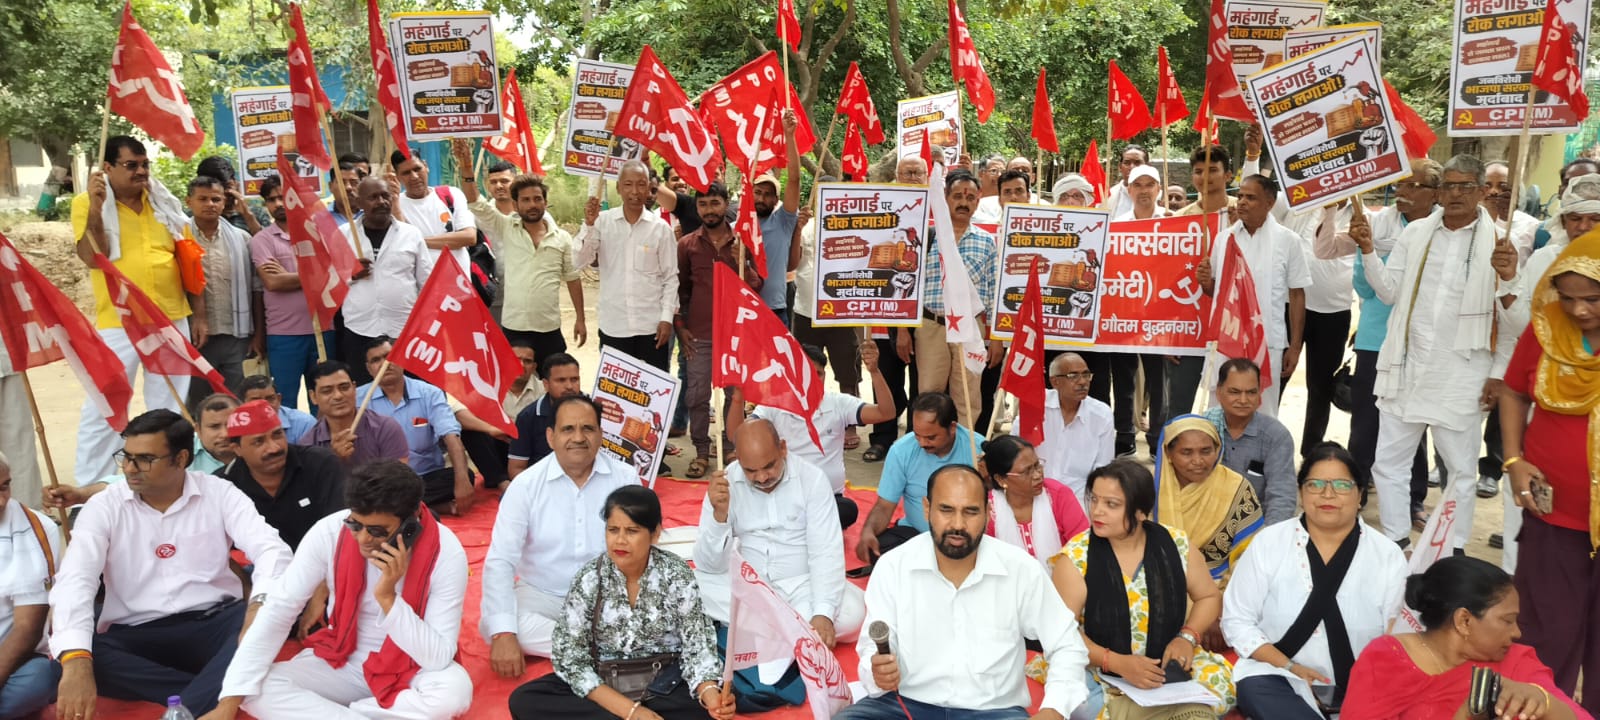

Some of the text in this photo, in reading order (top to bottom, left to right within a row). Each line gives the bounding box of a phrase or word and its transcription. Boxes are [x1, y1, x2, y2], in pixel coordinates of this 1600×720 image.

[1230, 8, 1279, 25] महंगाई
[1467, 10, 1545, 32] रोक लगाओ
[403, 21, 463, 40] महंगाई पर
[1230, 25, 1287, 39] रोक लगाओ
[407, 38, 468, 54] रोक लगाओ!
[579, 68, 626, 86] महंगाई पर
[1257, 62, 1332, 101] महंगाई पर
[238, 95, 277, 113] महंगाई
[1267, 75, 1343, 117] रोक लगाओ!
[438, 115, 483, 126] CPI (M)
[1489, 107, 1553, 120] CPI (M)
[586, 155, 605, 166] CP
[610, 158, 624, 169] (M
[1288, 142, 1357, 172] भाजपा सरकार
[1319, 167, 1353, 187] CPI
[1355, 160, 1377, 176] (M)
[825, 193, 893, 213] महंगाई पर
[827, 213, 897, 230] रोक लगाओ!
[1010, 214, 1075, 233] महंगाई पर
[1011, 233, 1077, 247] रोक लगाओ!
[827, 279, 888, 287] भाजपा सरकार
[847, 301, 898, 311] CPI (M)
[1056, 319, 1075, 329] (M)
[1142, 315, 1202, 341] बुद्धनगर)
[602, 362, 649, 391] महंगाई पर
[599, 378, 616, 393] रोक
